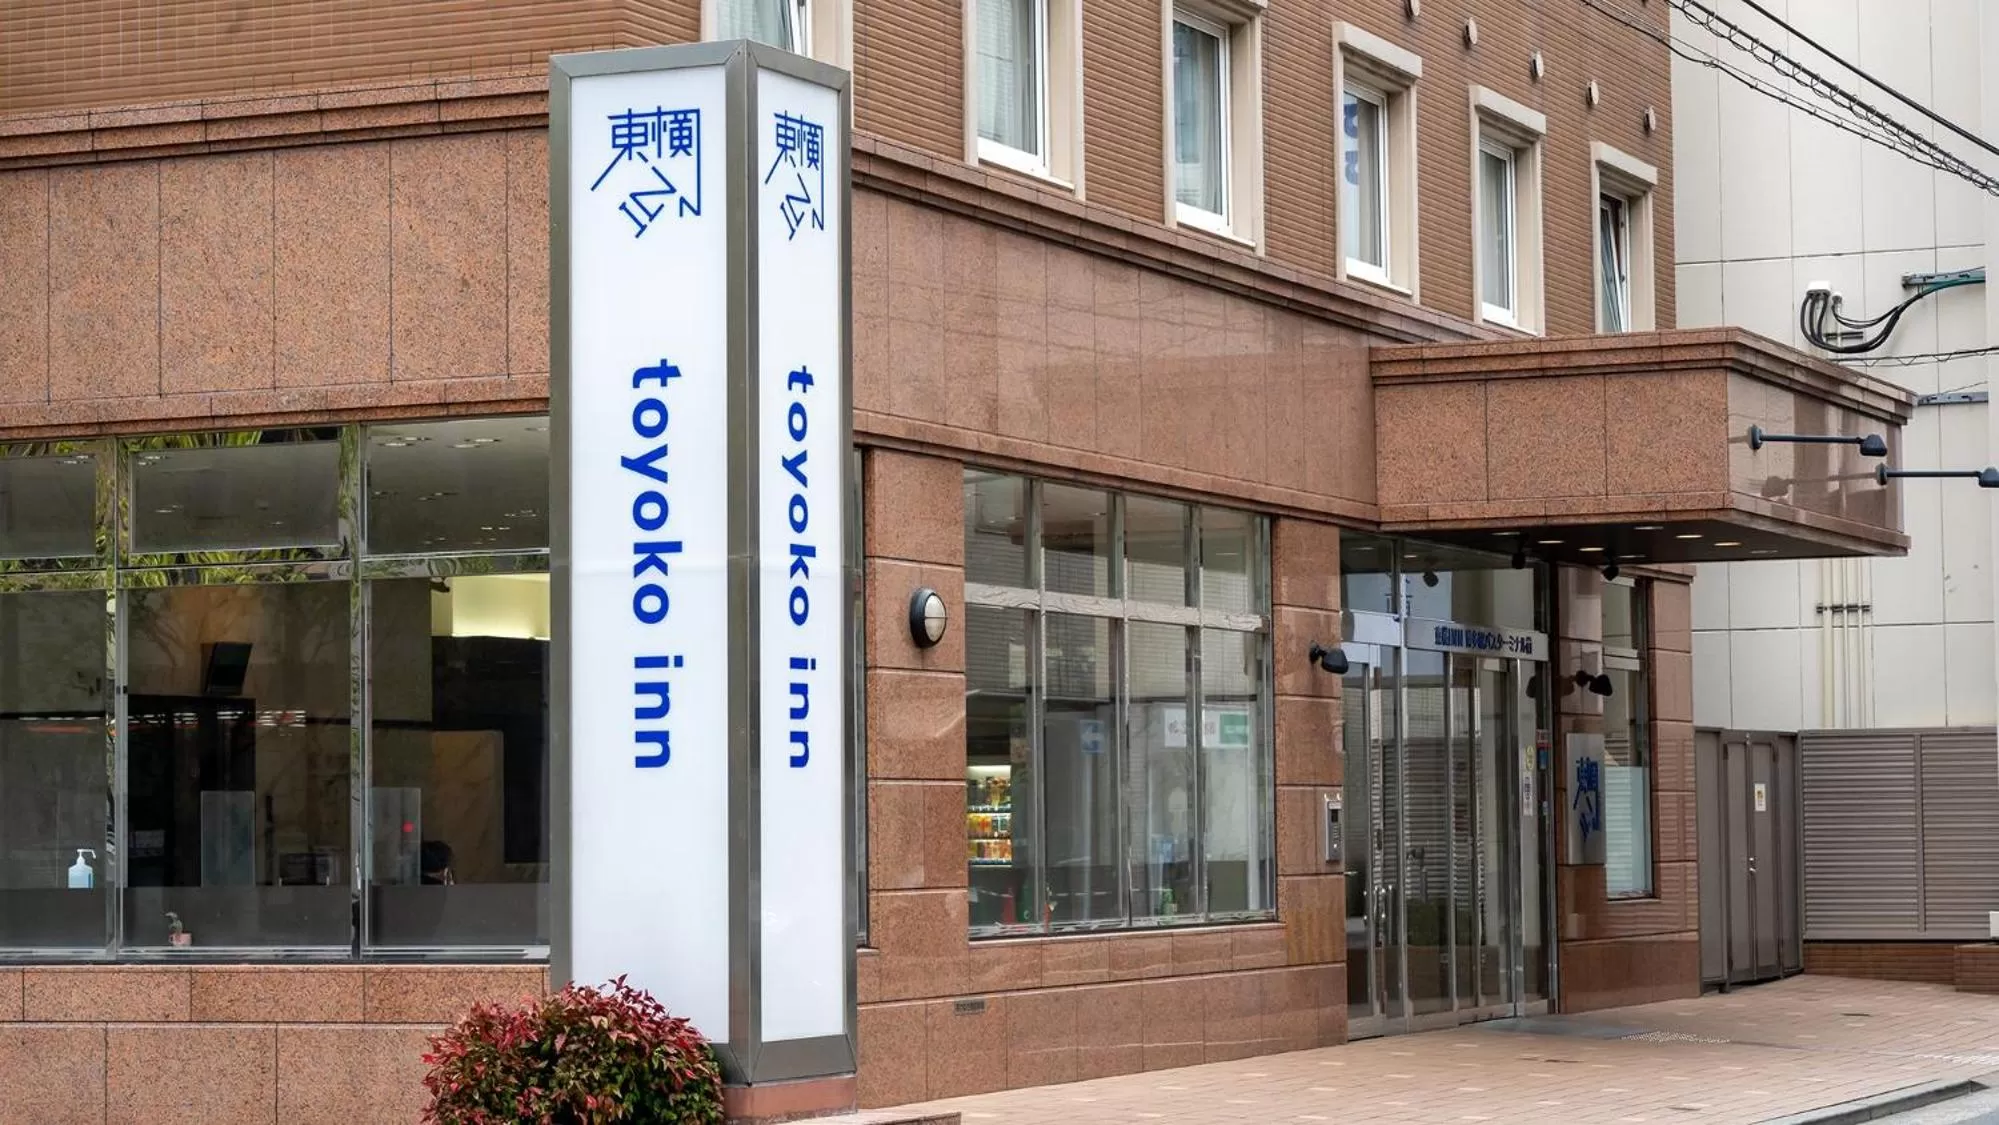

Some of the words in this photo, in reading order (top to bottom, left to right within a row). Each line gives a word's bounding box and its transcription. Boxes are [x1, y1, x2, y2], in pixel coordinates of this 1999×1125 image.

[620, 358, 683, 625] toyoko
[781, 365, 817, 627] toyoko
[633, 655, 685, 769] inn
[788, 656, 817, 769] inn
